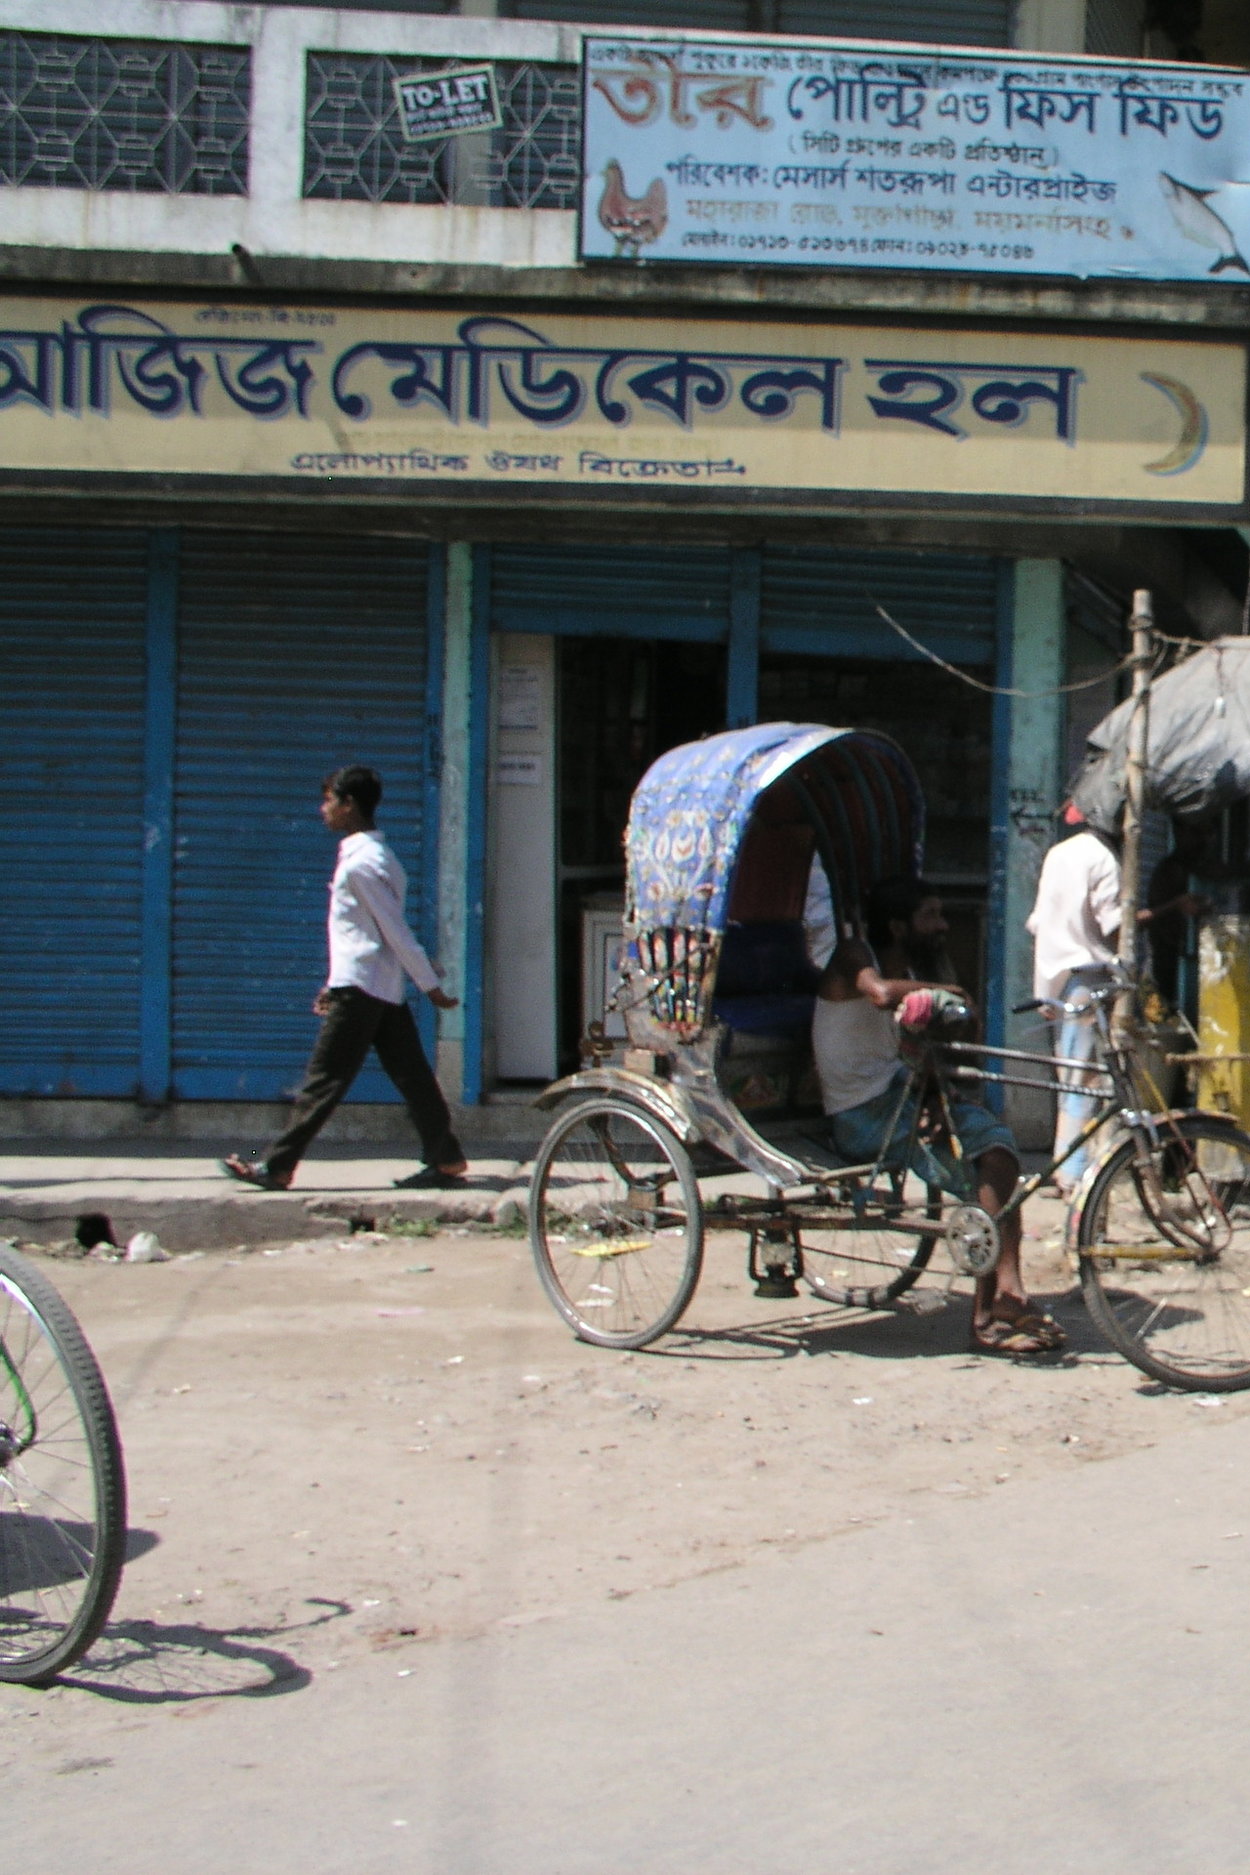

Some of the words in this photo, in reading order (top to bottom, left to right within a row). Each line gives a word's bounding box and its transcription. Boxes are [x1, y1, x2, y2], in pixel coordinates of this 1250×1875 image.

[402, 74, 488, 110] TO-LET
[998, 72, 1101, 134] ফিস
[1113, 79, 1223, 140] ফিড
[910, 137, 956, 160] একটি
[774, 159, 850, 191] মেসার্স
[0, 304, 321, 420] আজিজ
[333, 316, 844, 438] মেডিকেল
[863, 357, 1082, 445] হল
[485, 450, 563, 474] ঔষধ
